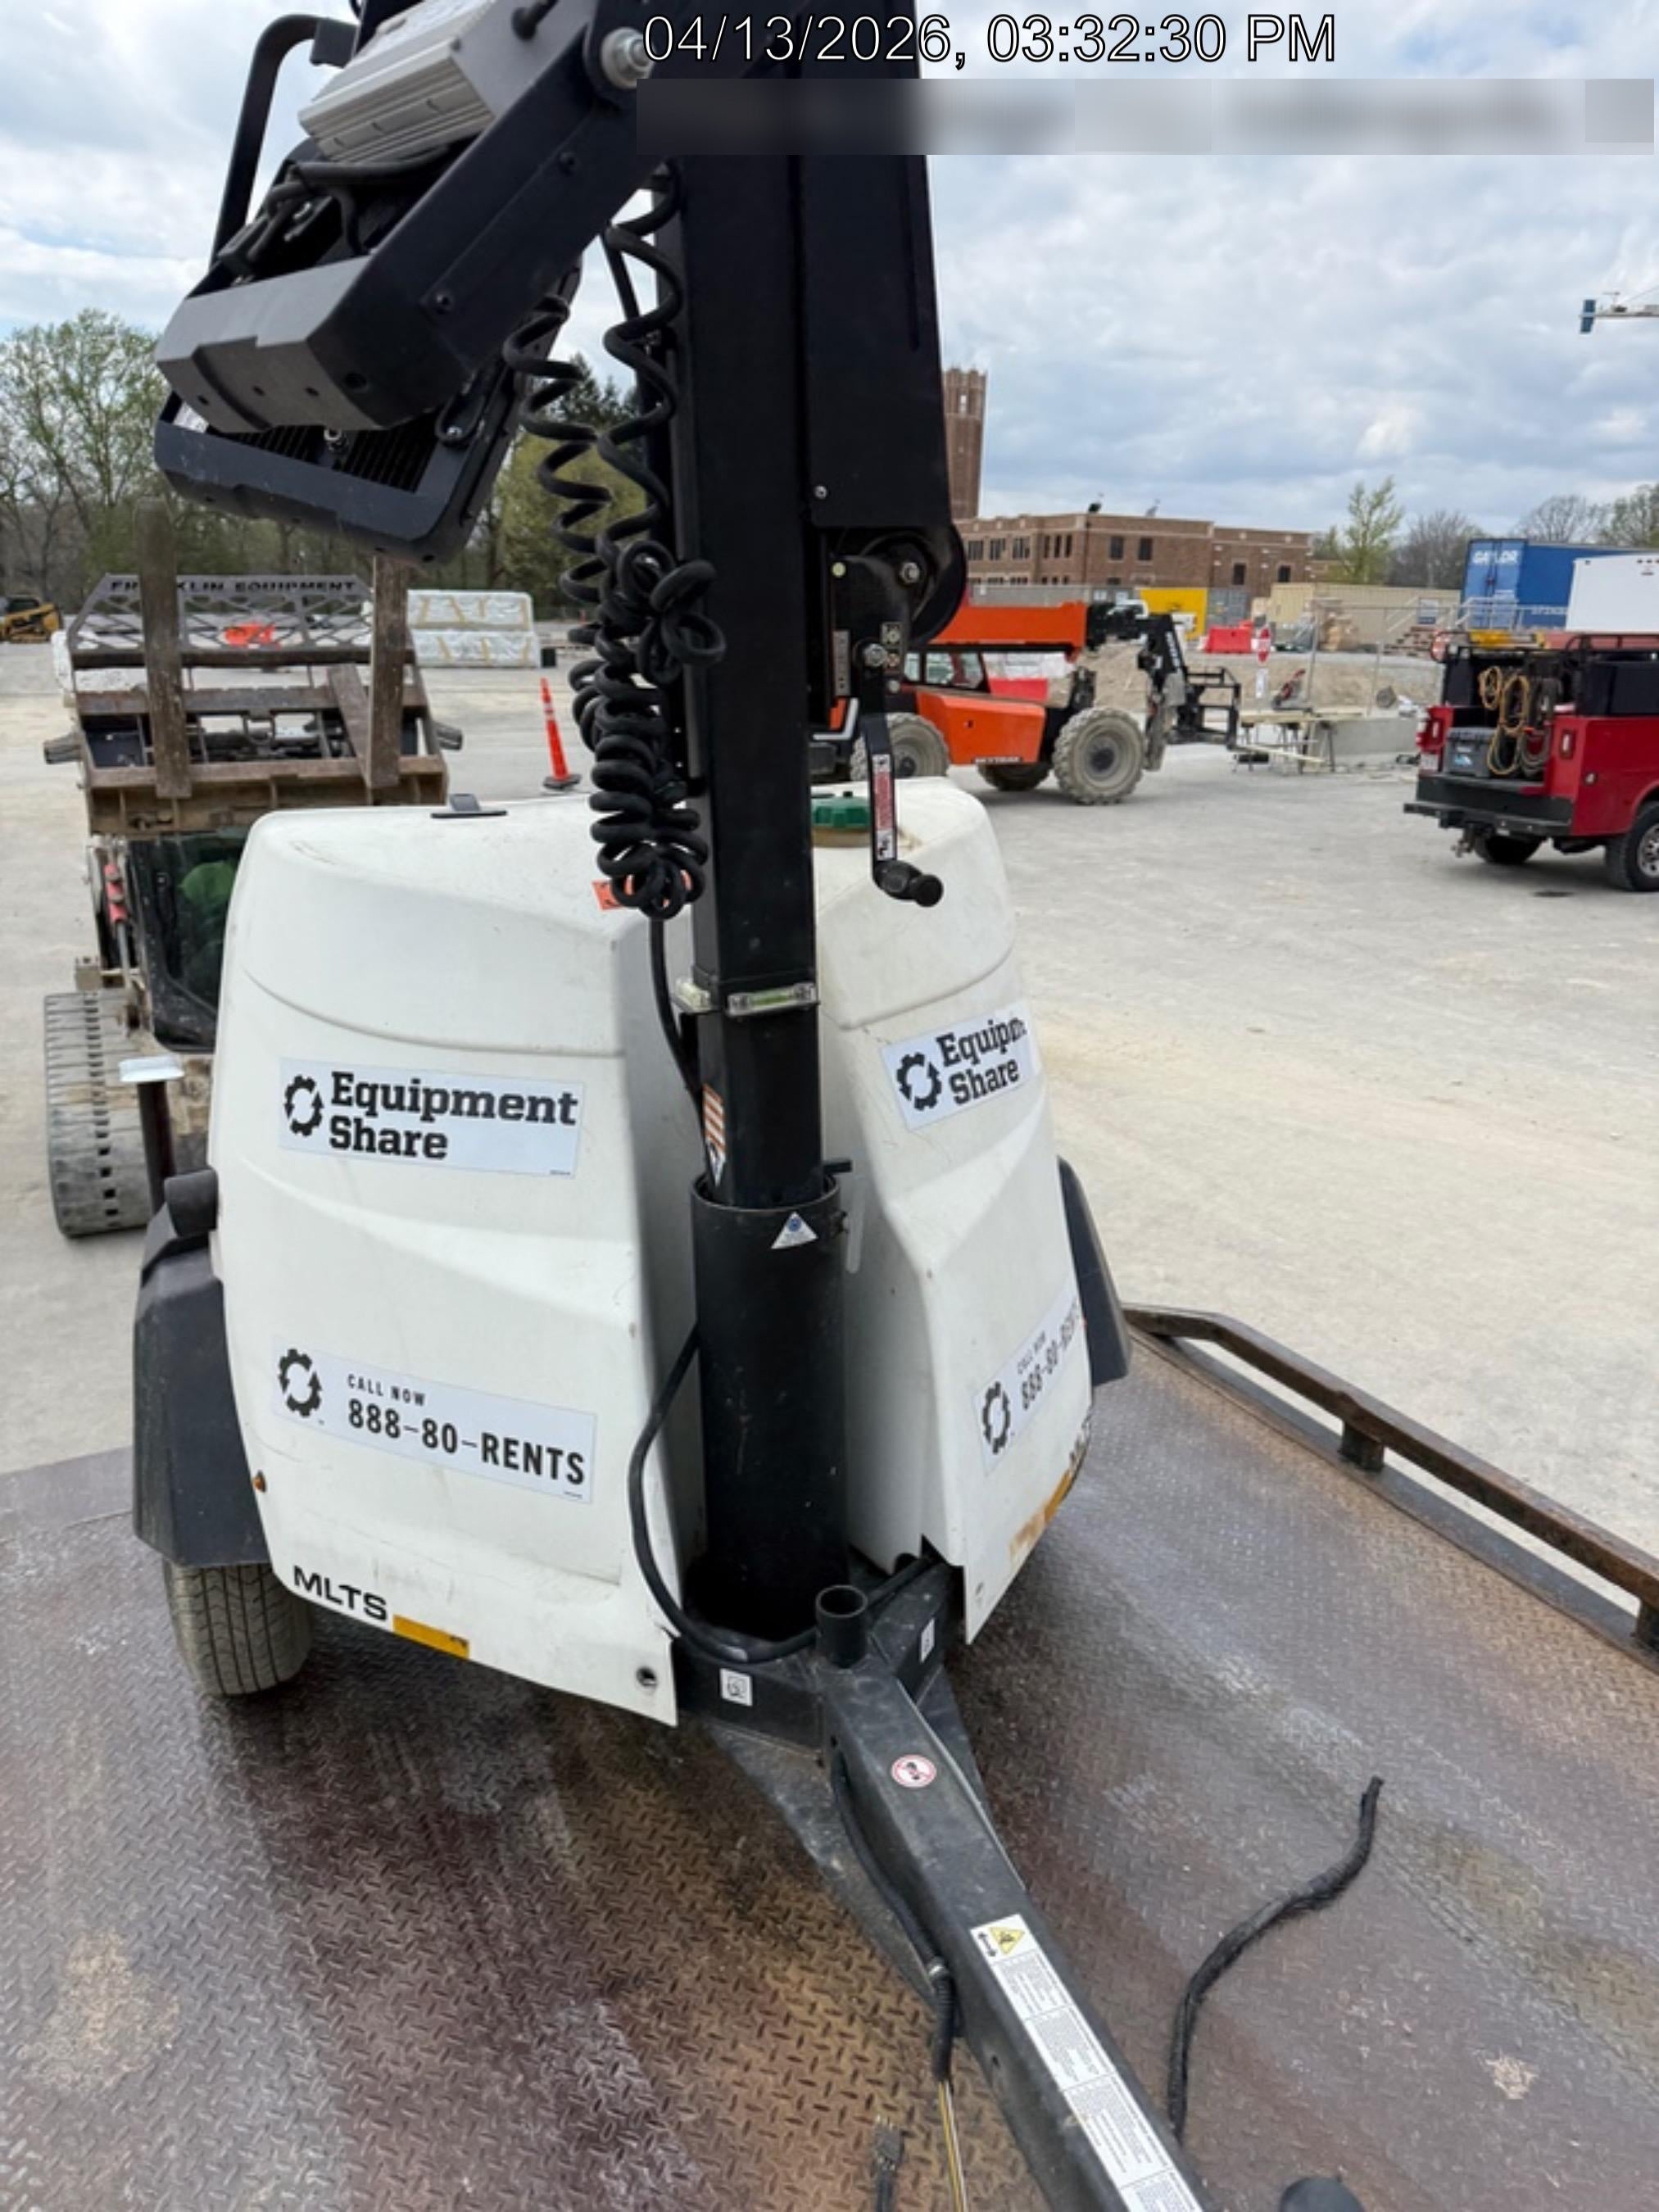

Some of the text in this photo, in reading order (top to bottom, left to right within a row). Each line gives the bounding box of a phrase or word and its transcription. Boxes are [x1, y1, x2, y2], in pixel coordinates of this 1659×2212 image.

[234, 581, 356, 592] EQUIPMENT
[330, 1070, 578, 1126] Equipment
[949, 1058, 1019, 1105] Share
[329, 1115, 448, 1160] Share
[347, 1373, 426, 1407] CALL NOW
[348, 1398, 585, 1485] 888-80-RENTS
[293, 1564, 388, 1622] MLTS
